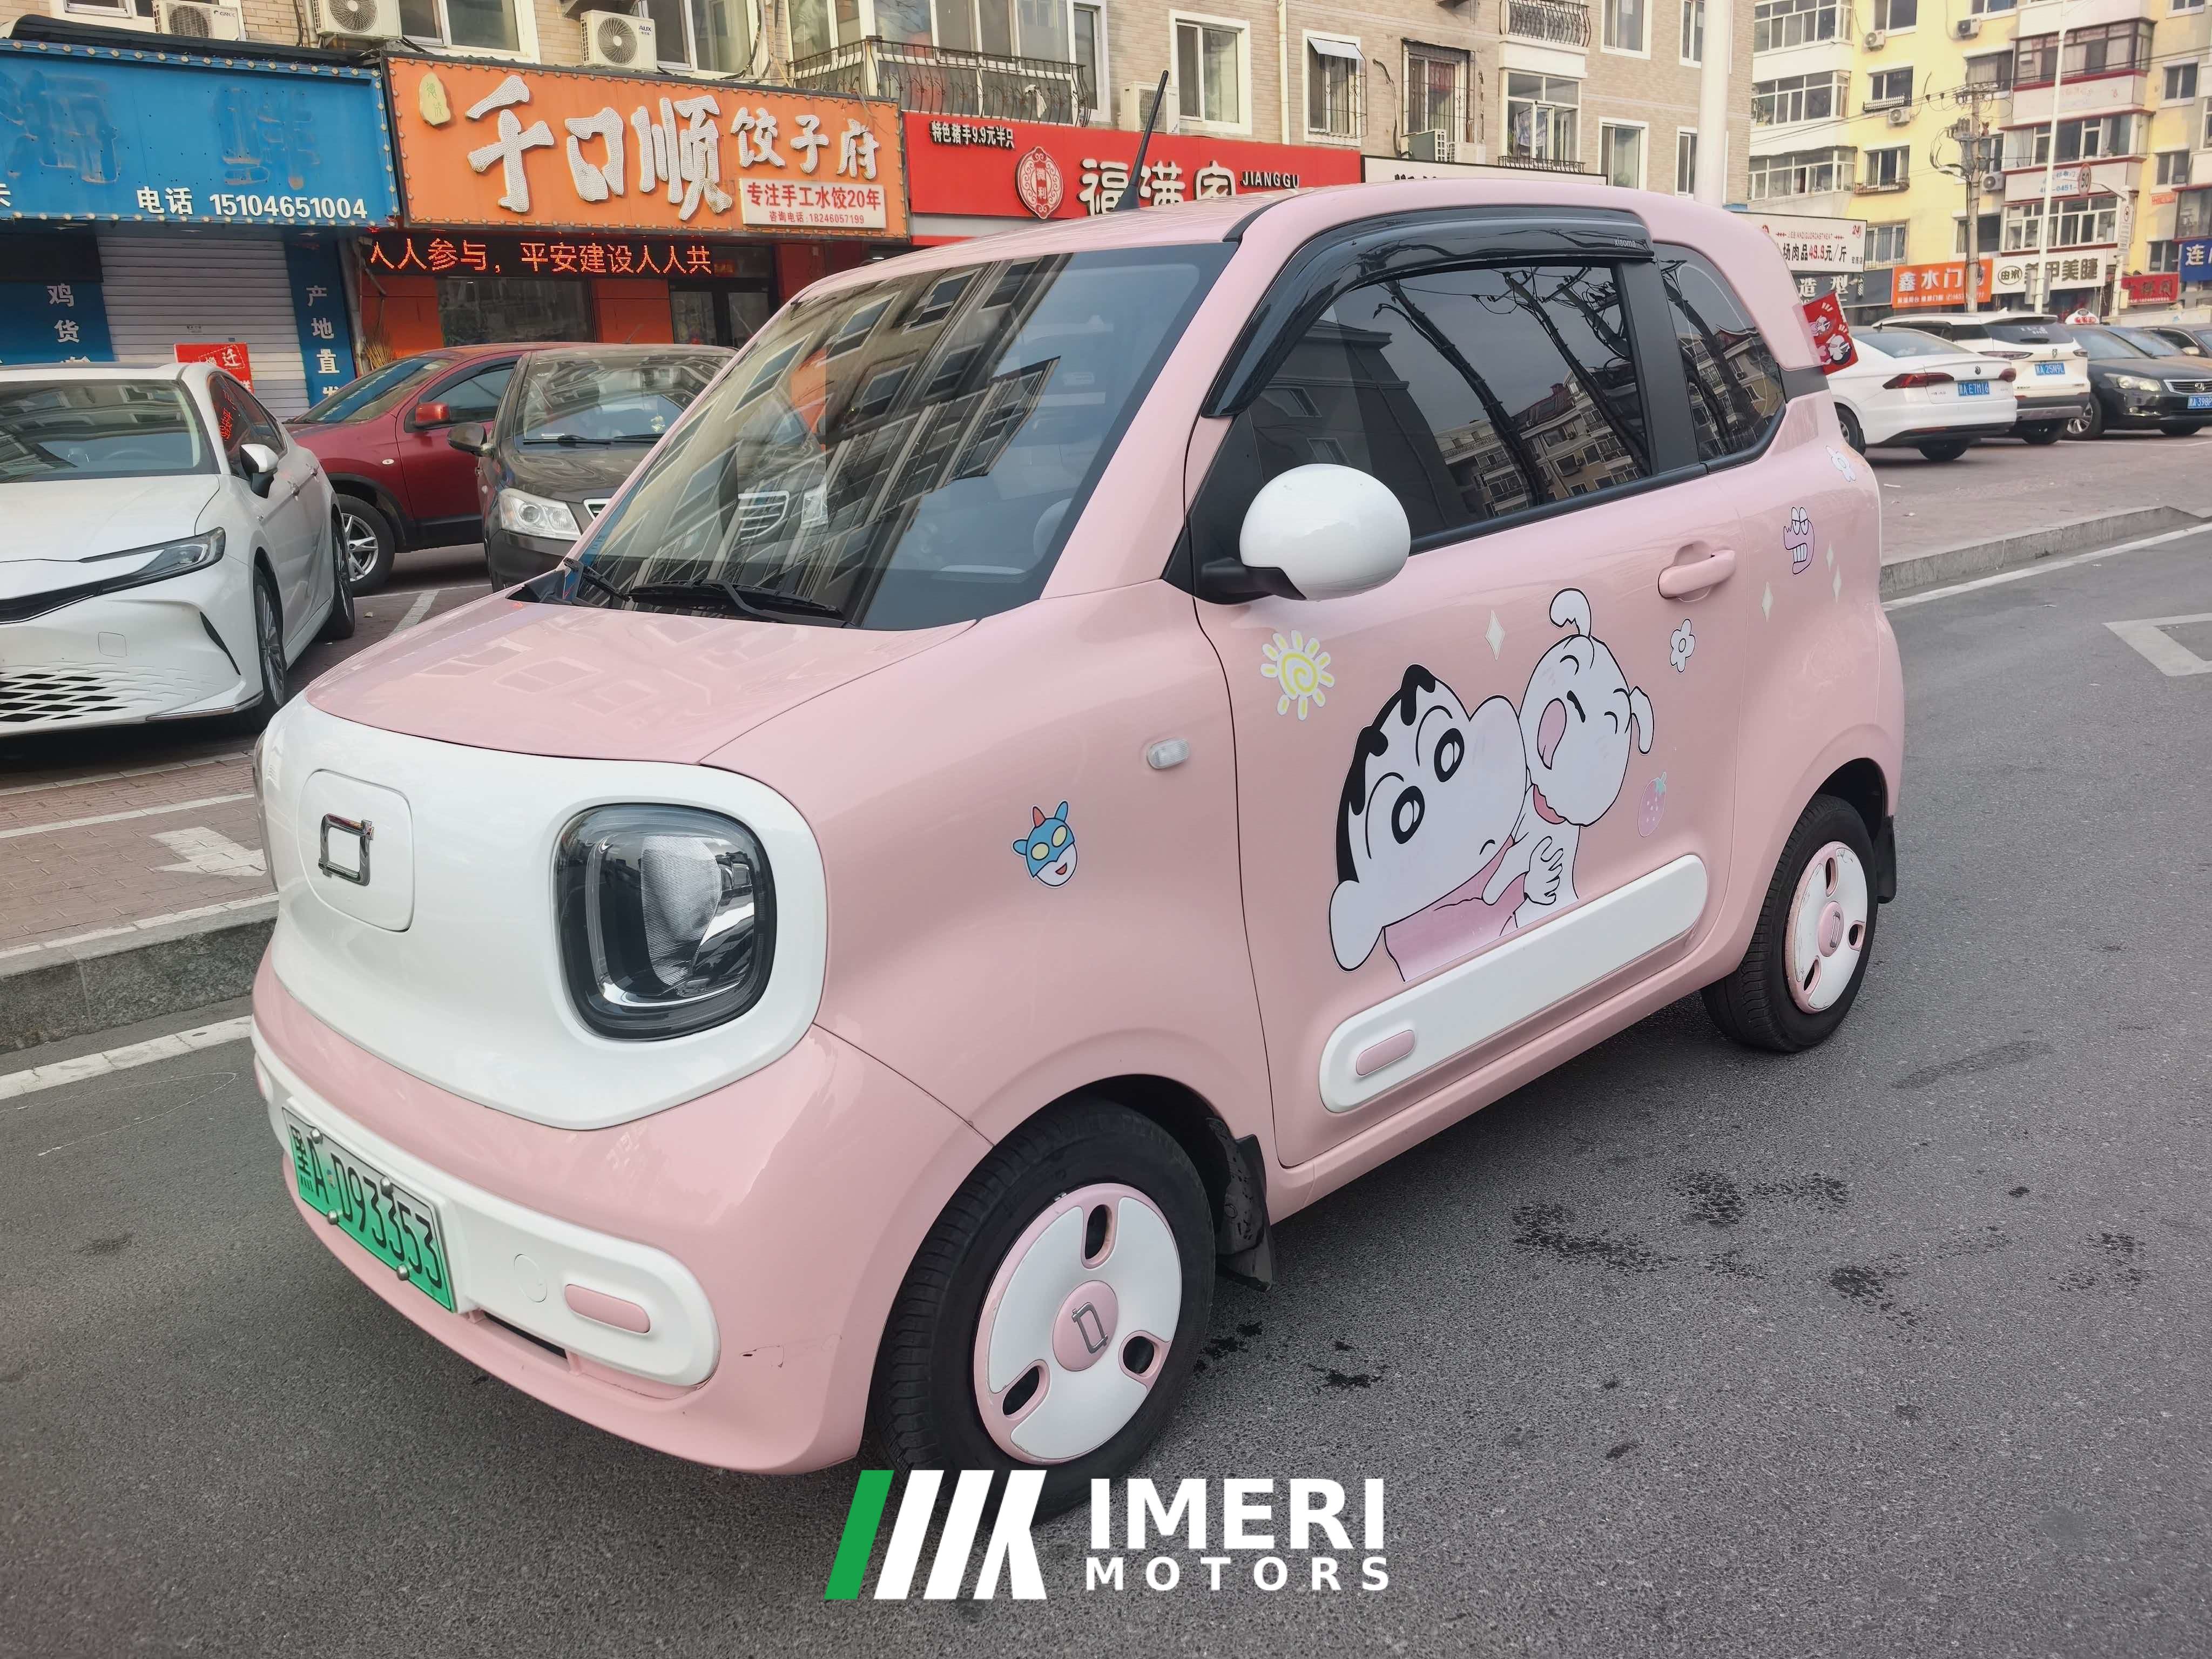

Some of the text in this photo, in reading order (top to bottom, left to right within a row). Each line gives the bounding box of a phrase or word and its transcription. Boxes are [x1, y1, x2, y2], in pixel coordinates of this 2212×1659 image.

[466, 75, 880, 220] 千口顺 饺子府
[931, 120, 1015, 149] 特色猪手9.9元半只
[2081, 172, 2090, 188] 50
[136, 186, 368, 219] 电话 15104651004
[747, 181, 881, 211] 专注手工水饺20年
[1777, 242, 1847, 262] 场肉品49.9元/斤
[1898, 268, 1985, 292] 鑫水门
[2025, 258, 2098, 285] 甲美睫
[47, 283, 90, 363] 鸡货
